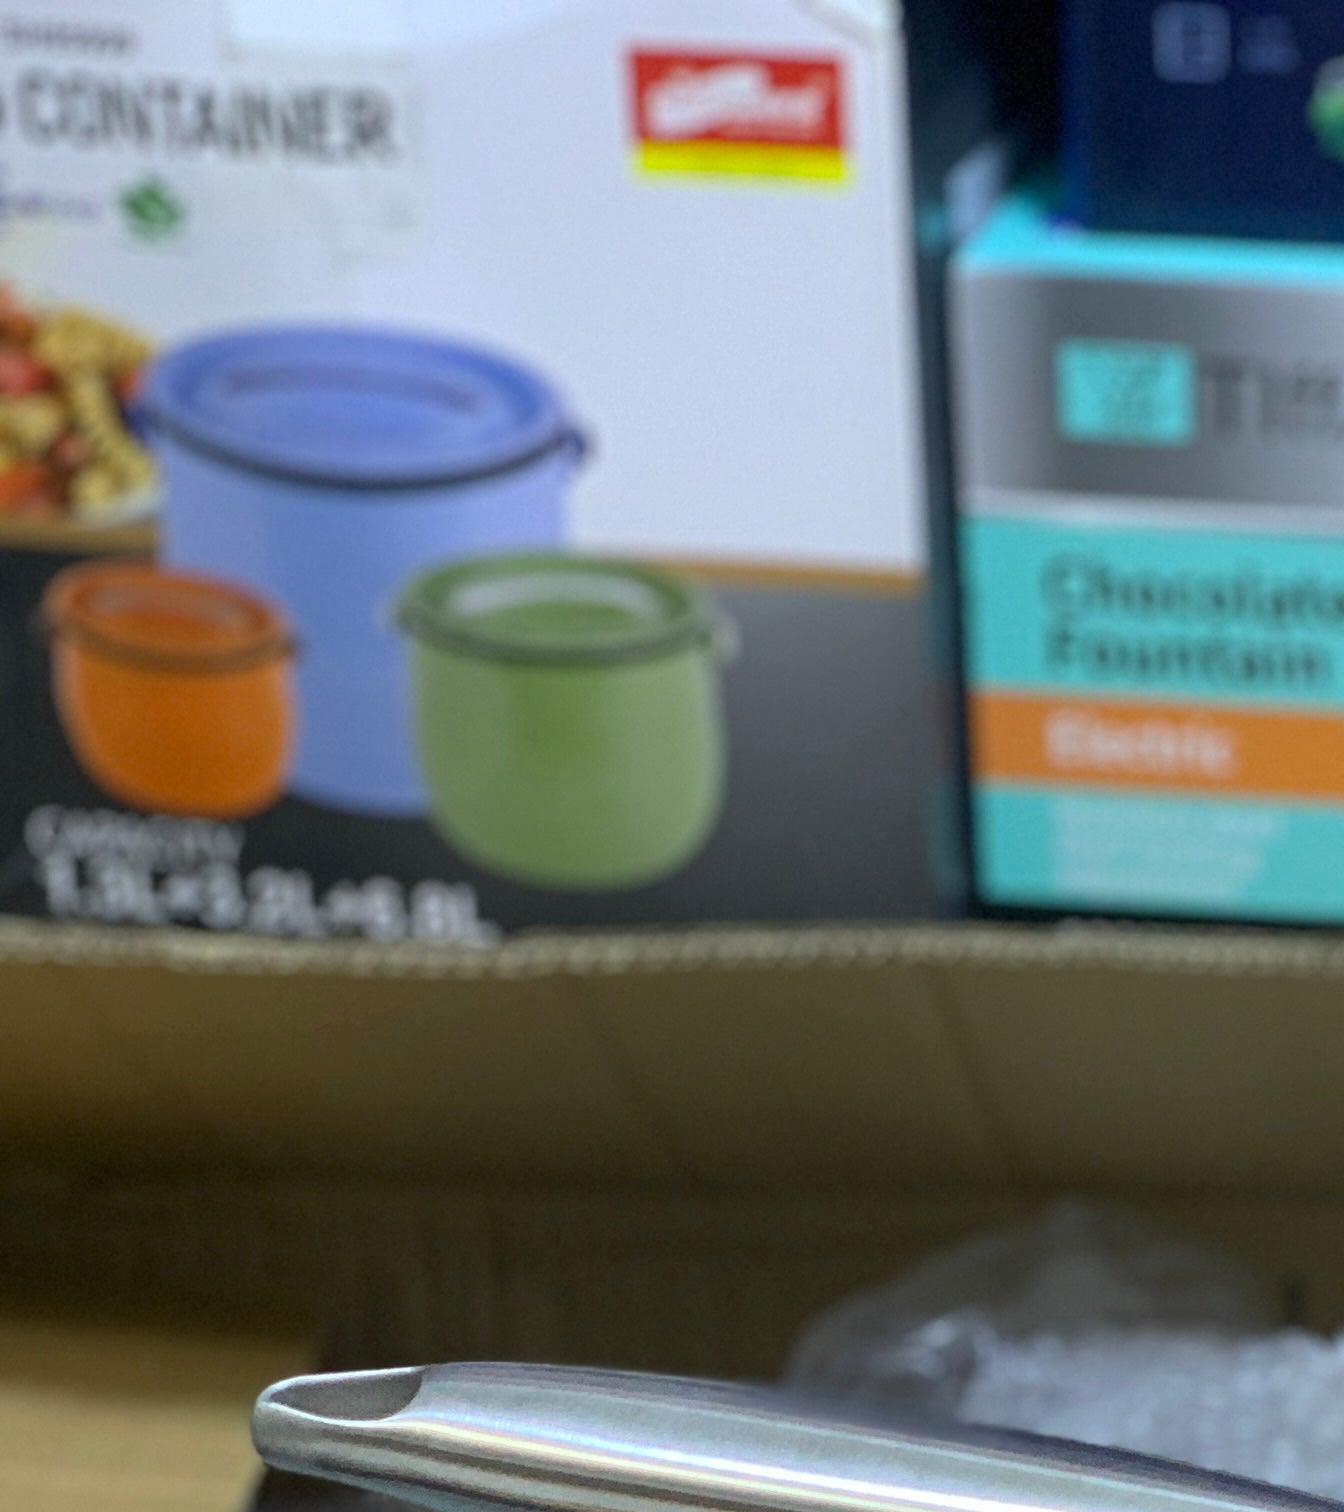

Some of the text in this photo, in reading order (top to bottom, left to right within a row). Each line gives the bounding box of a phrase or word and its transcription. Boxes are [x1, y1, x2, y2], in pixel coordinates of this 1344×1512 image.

[20, 66, 402, 162] CONTAINER
[1044, 622, 1332, 689] Fountain
[1044, 712, 1240, 778] Electric
